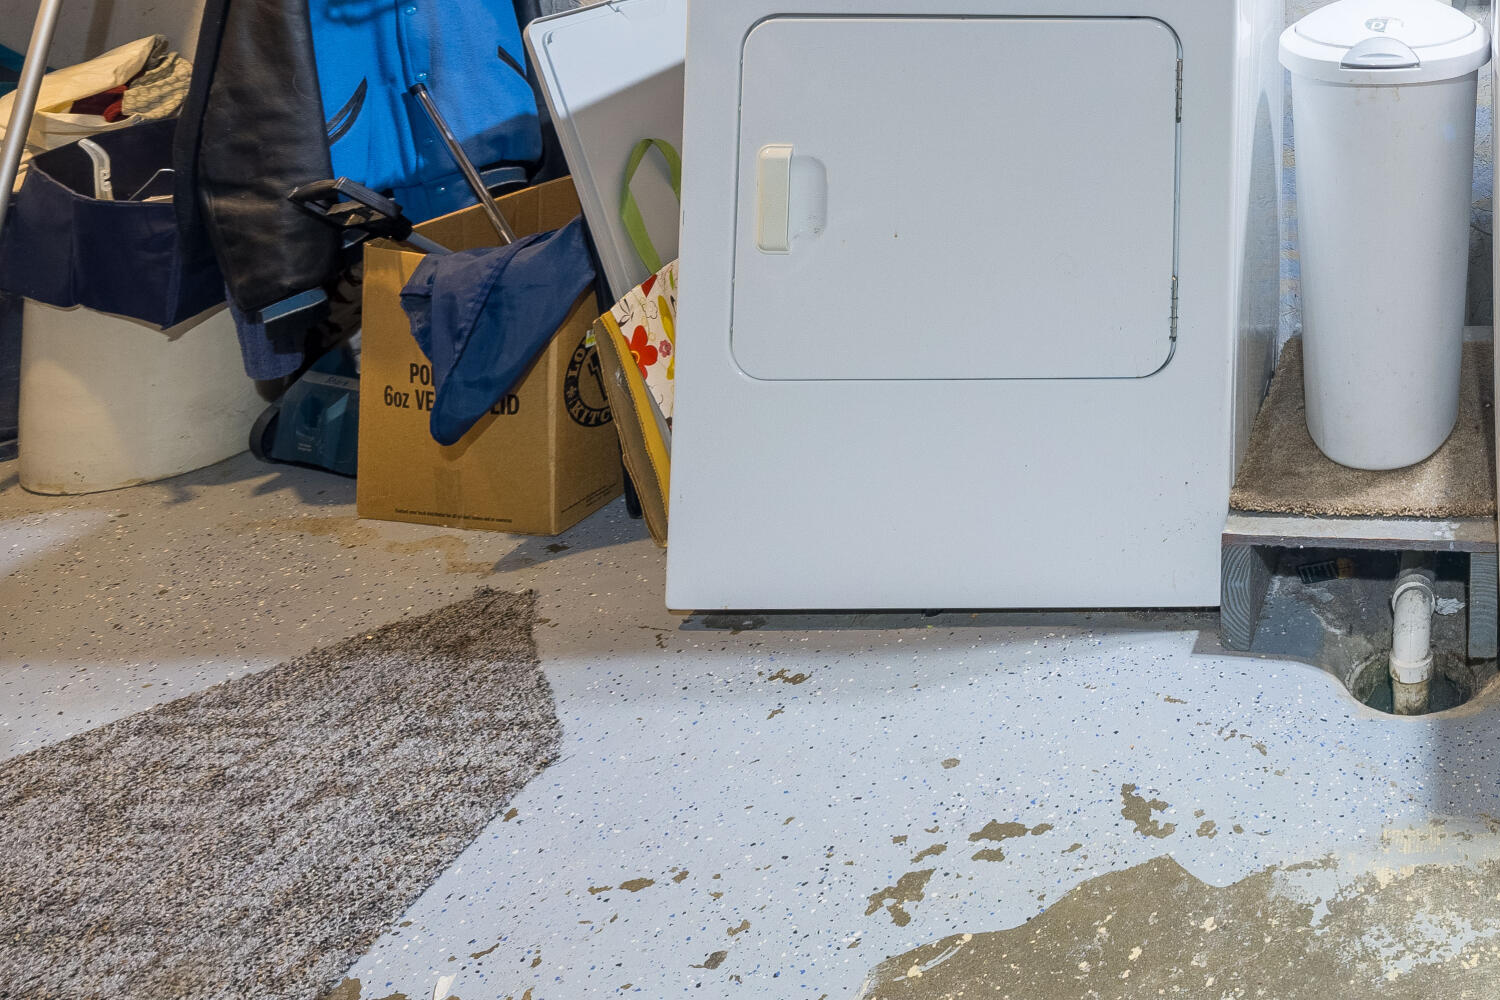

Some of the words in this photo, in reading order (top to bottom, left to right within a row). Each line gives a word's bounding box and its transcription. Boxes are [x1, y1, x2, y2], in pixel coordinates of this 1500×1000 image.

[409, 362, 433, 386] PO
[384, 385, 410, 409] 6oz
[489, 393, 520, 416] LID
